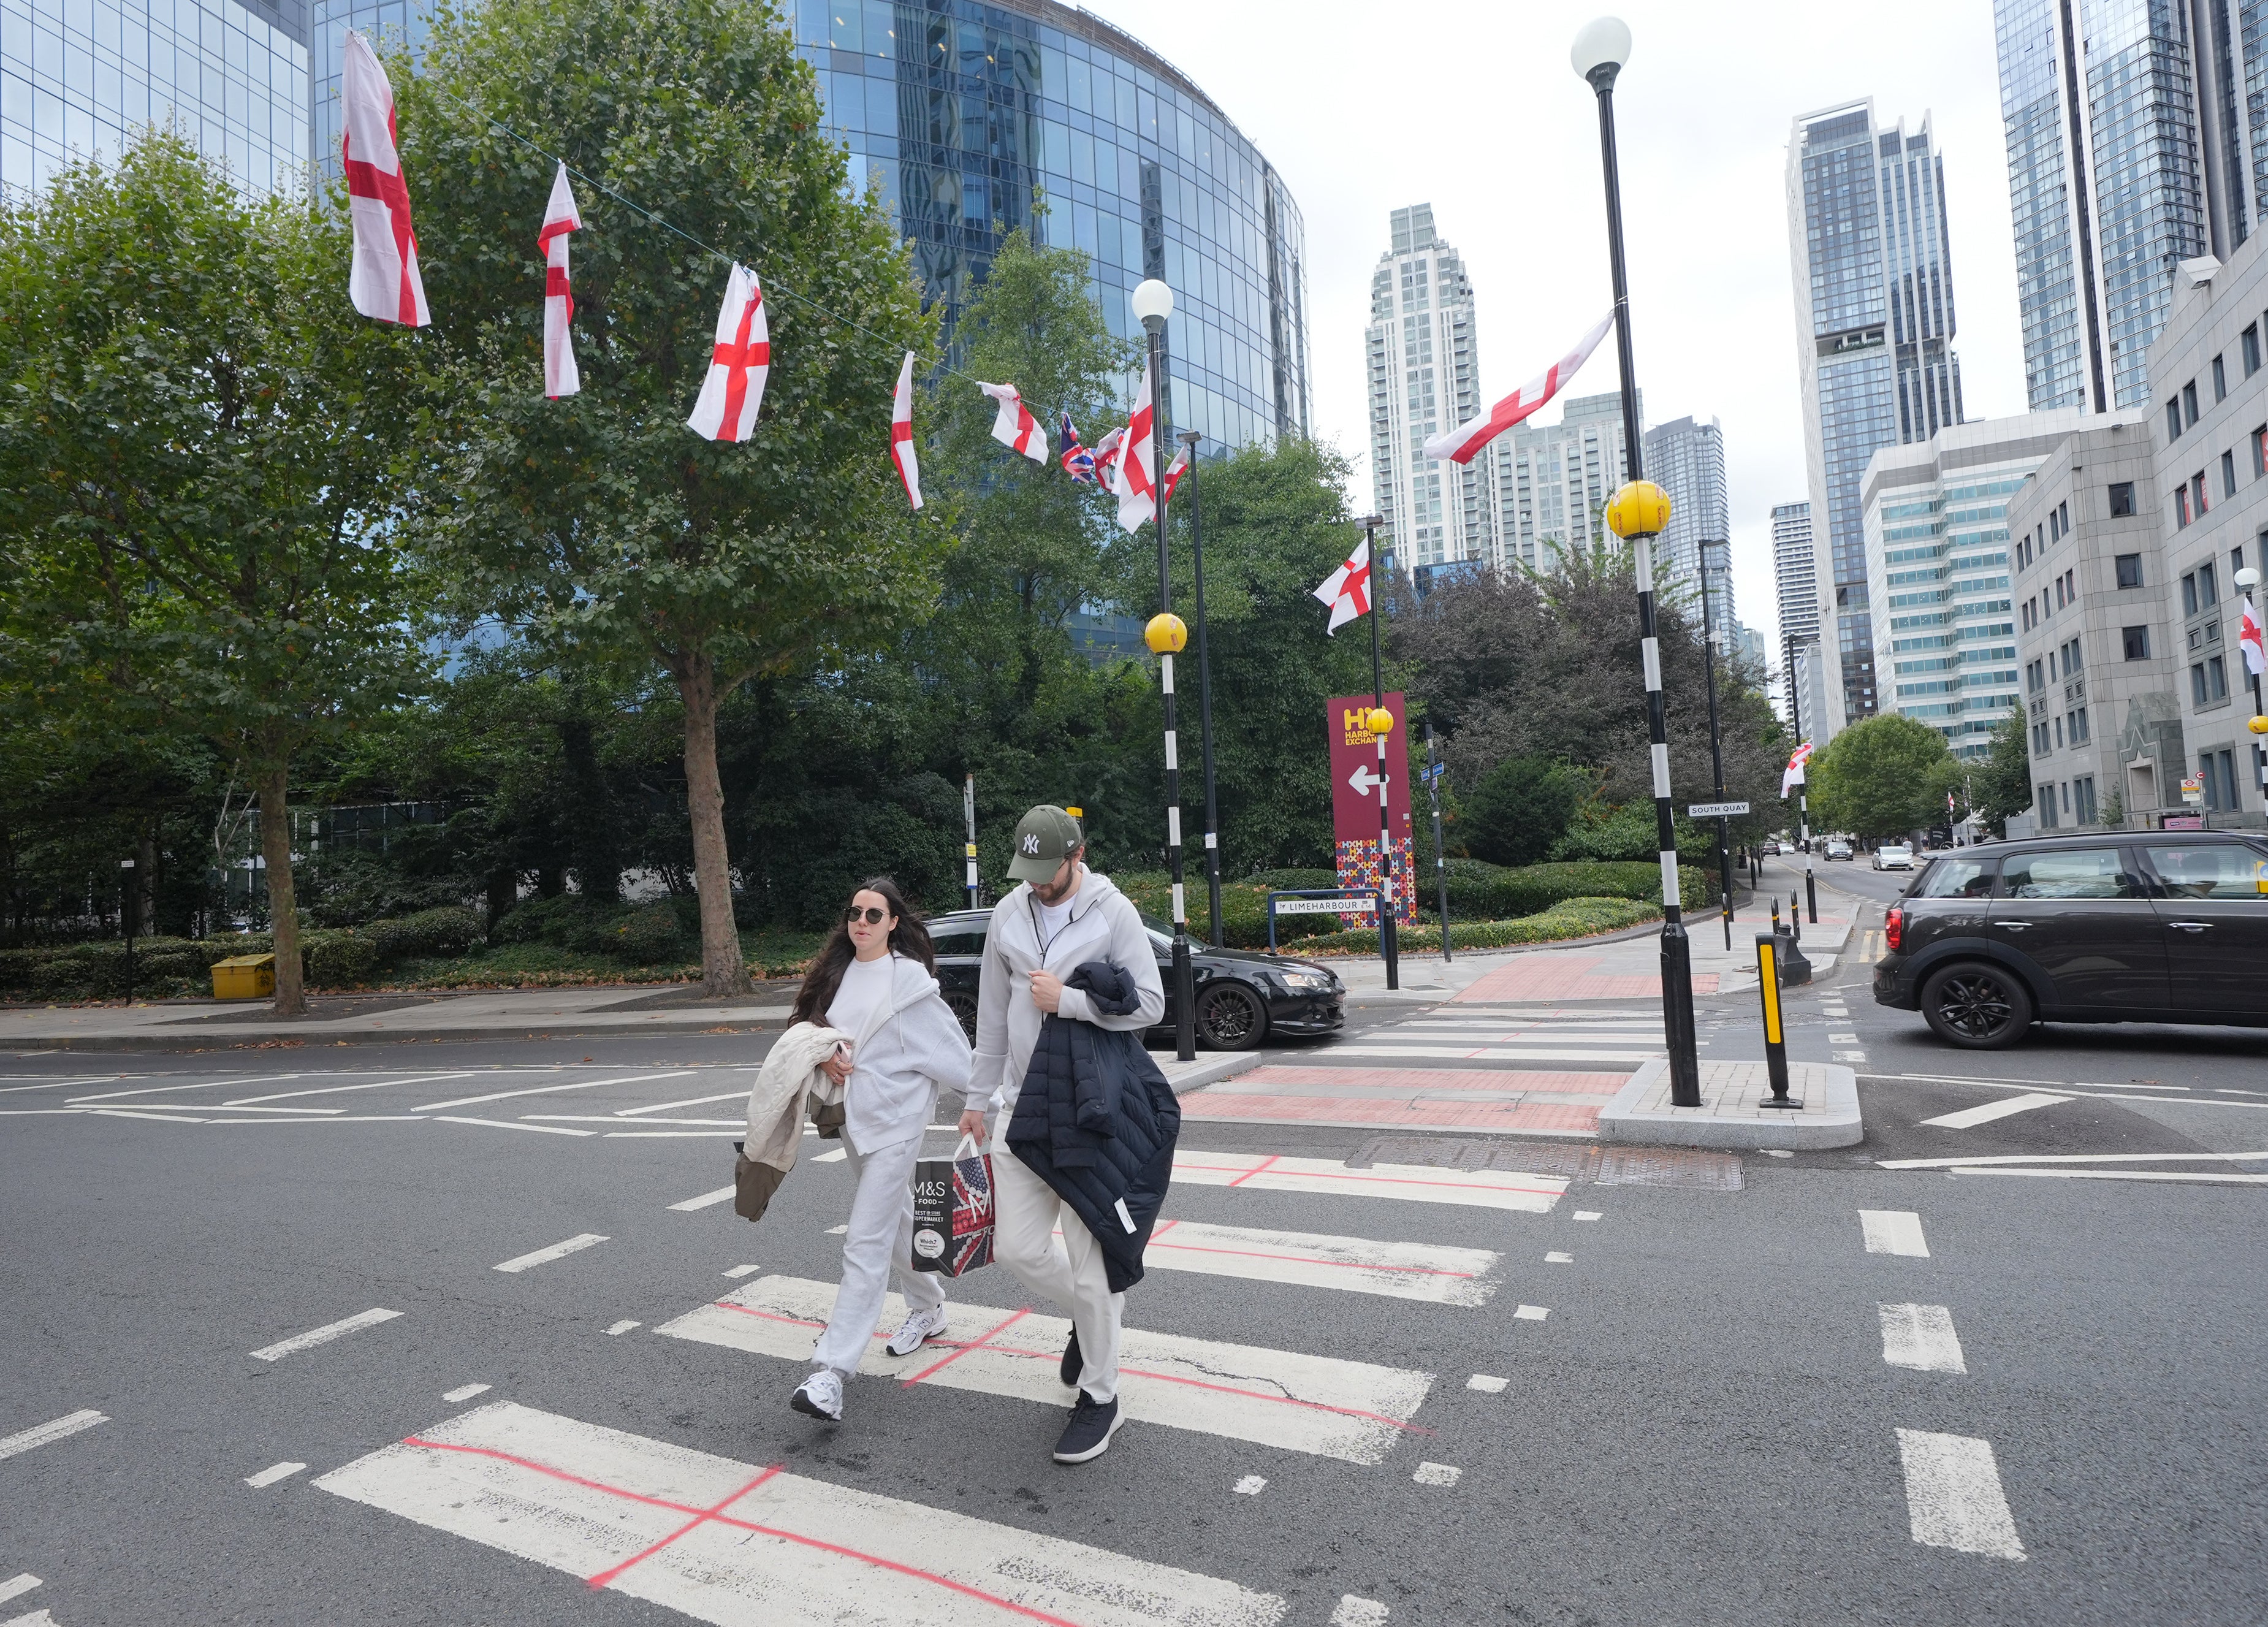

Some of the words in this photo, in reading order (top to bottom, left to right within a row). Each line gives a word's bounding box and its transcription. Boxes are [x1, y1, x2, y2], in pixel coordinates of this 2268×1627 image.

[1345, 736, 1388, 745] EXCHANE
[1022, 833, 1040, 854] NY
[1290, 901, 1357, 911] LIMEHARBOUR
[915, 1181, 945, 1197] M&S
